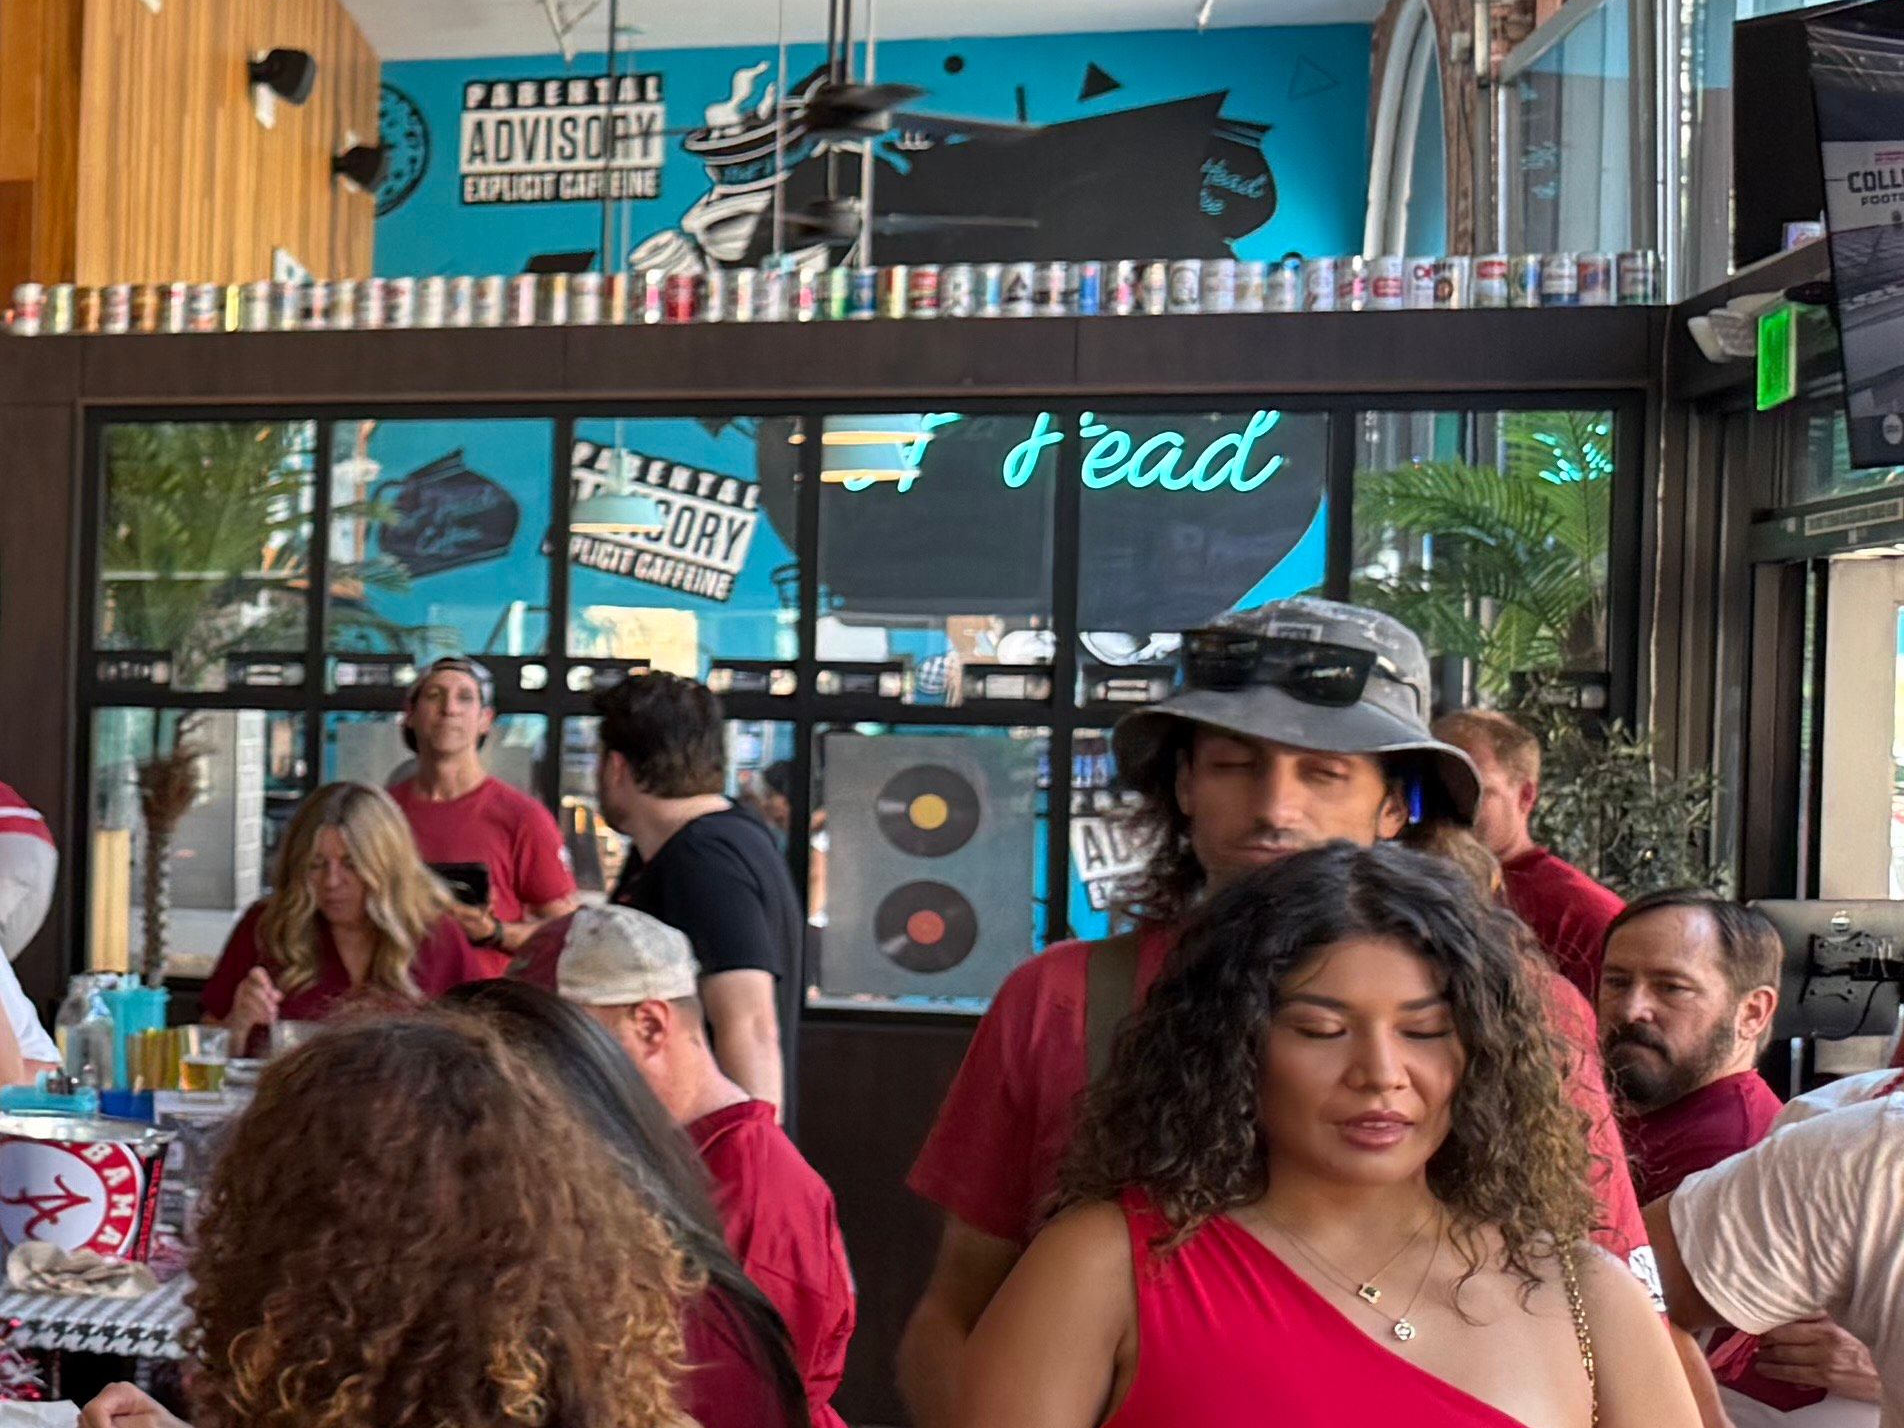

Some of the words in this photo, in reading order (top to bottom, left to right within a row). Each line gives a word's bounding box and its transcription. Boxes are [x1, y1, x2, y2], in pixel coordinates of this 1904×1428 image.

[466, 76, 661, 109] PARENTAL
[467, 112, 657, 164] ADVISORY
[463, 175, 558, 203] EXPLICIT
[1847, 171, 1904, 193] COLL
[634, 551, 734, 601] CAFFEINE
